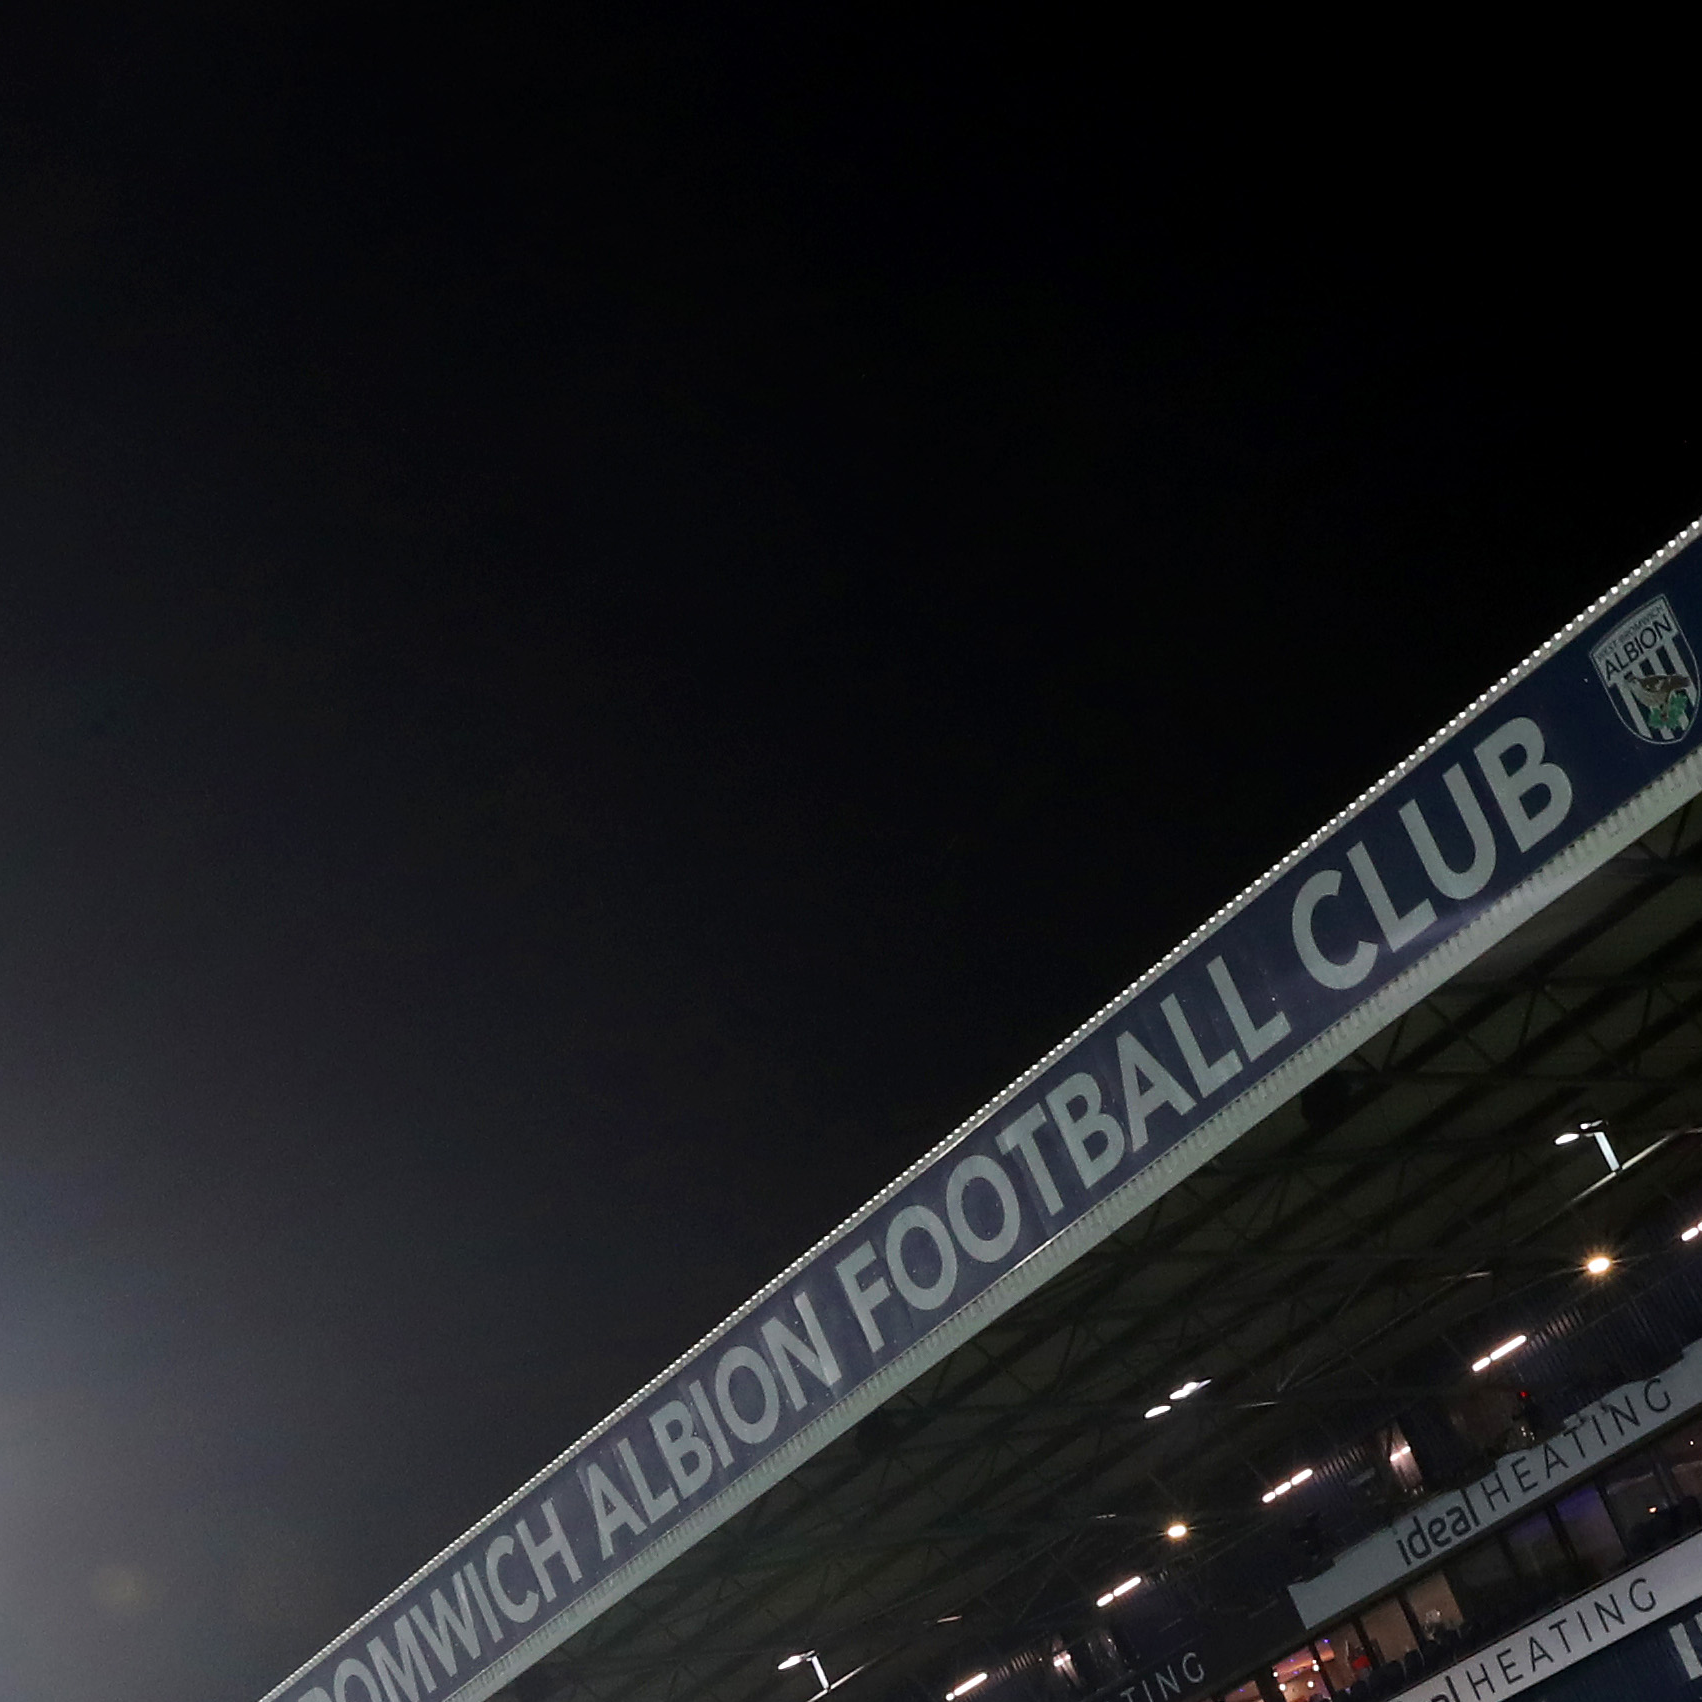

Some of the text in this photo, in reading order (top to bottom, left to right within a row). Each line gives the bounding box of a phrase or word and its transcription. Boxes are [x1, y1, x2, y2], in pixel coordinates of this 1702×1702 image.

[1603, 613, 1675, 682] ALBION
[576, 1294, 842, 1560] ALBION
[837, 954, 1292, 1354] FOOTBALL
[1290, 715, 1574, 991] CLUB
[1394, 1376, 1674, 1566] ideal HEATING
[1468, 1577, 1658, 1702] HEATING
